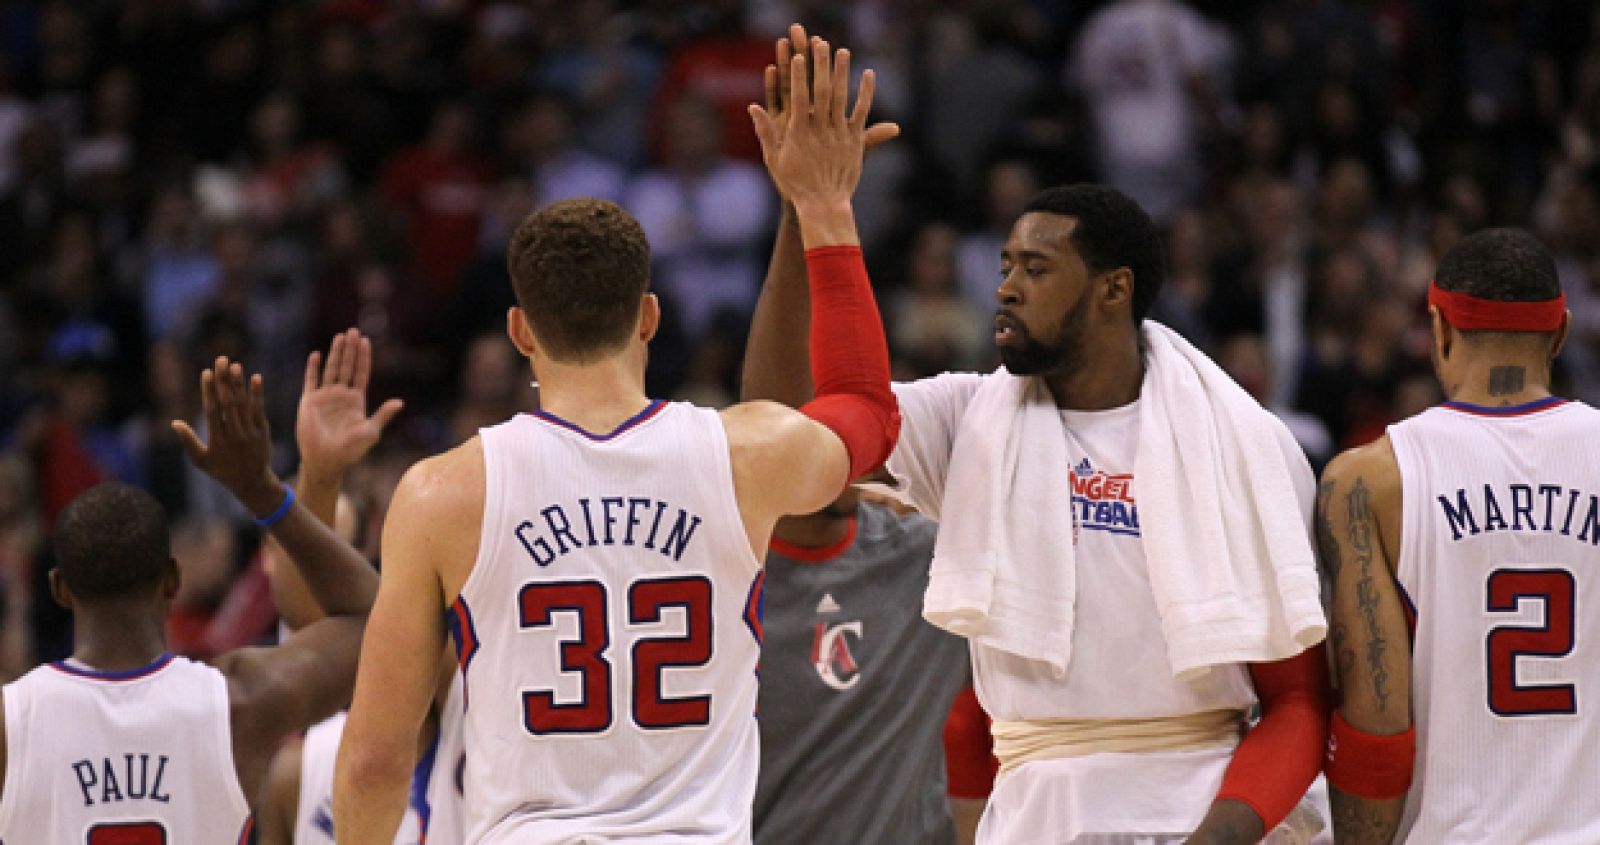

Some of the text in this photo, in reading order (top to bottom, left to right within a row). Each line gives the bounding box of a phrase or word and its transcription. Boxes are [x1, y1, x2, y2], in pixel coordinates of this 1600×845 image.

[514, 496, 702, 567] GRIFFIN
[518, 575, 713, 736] 32
[1486, 567, 1577, 717] 2
[72, 753, 169, 807] PAUL
